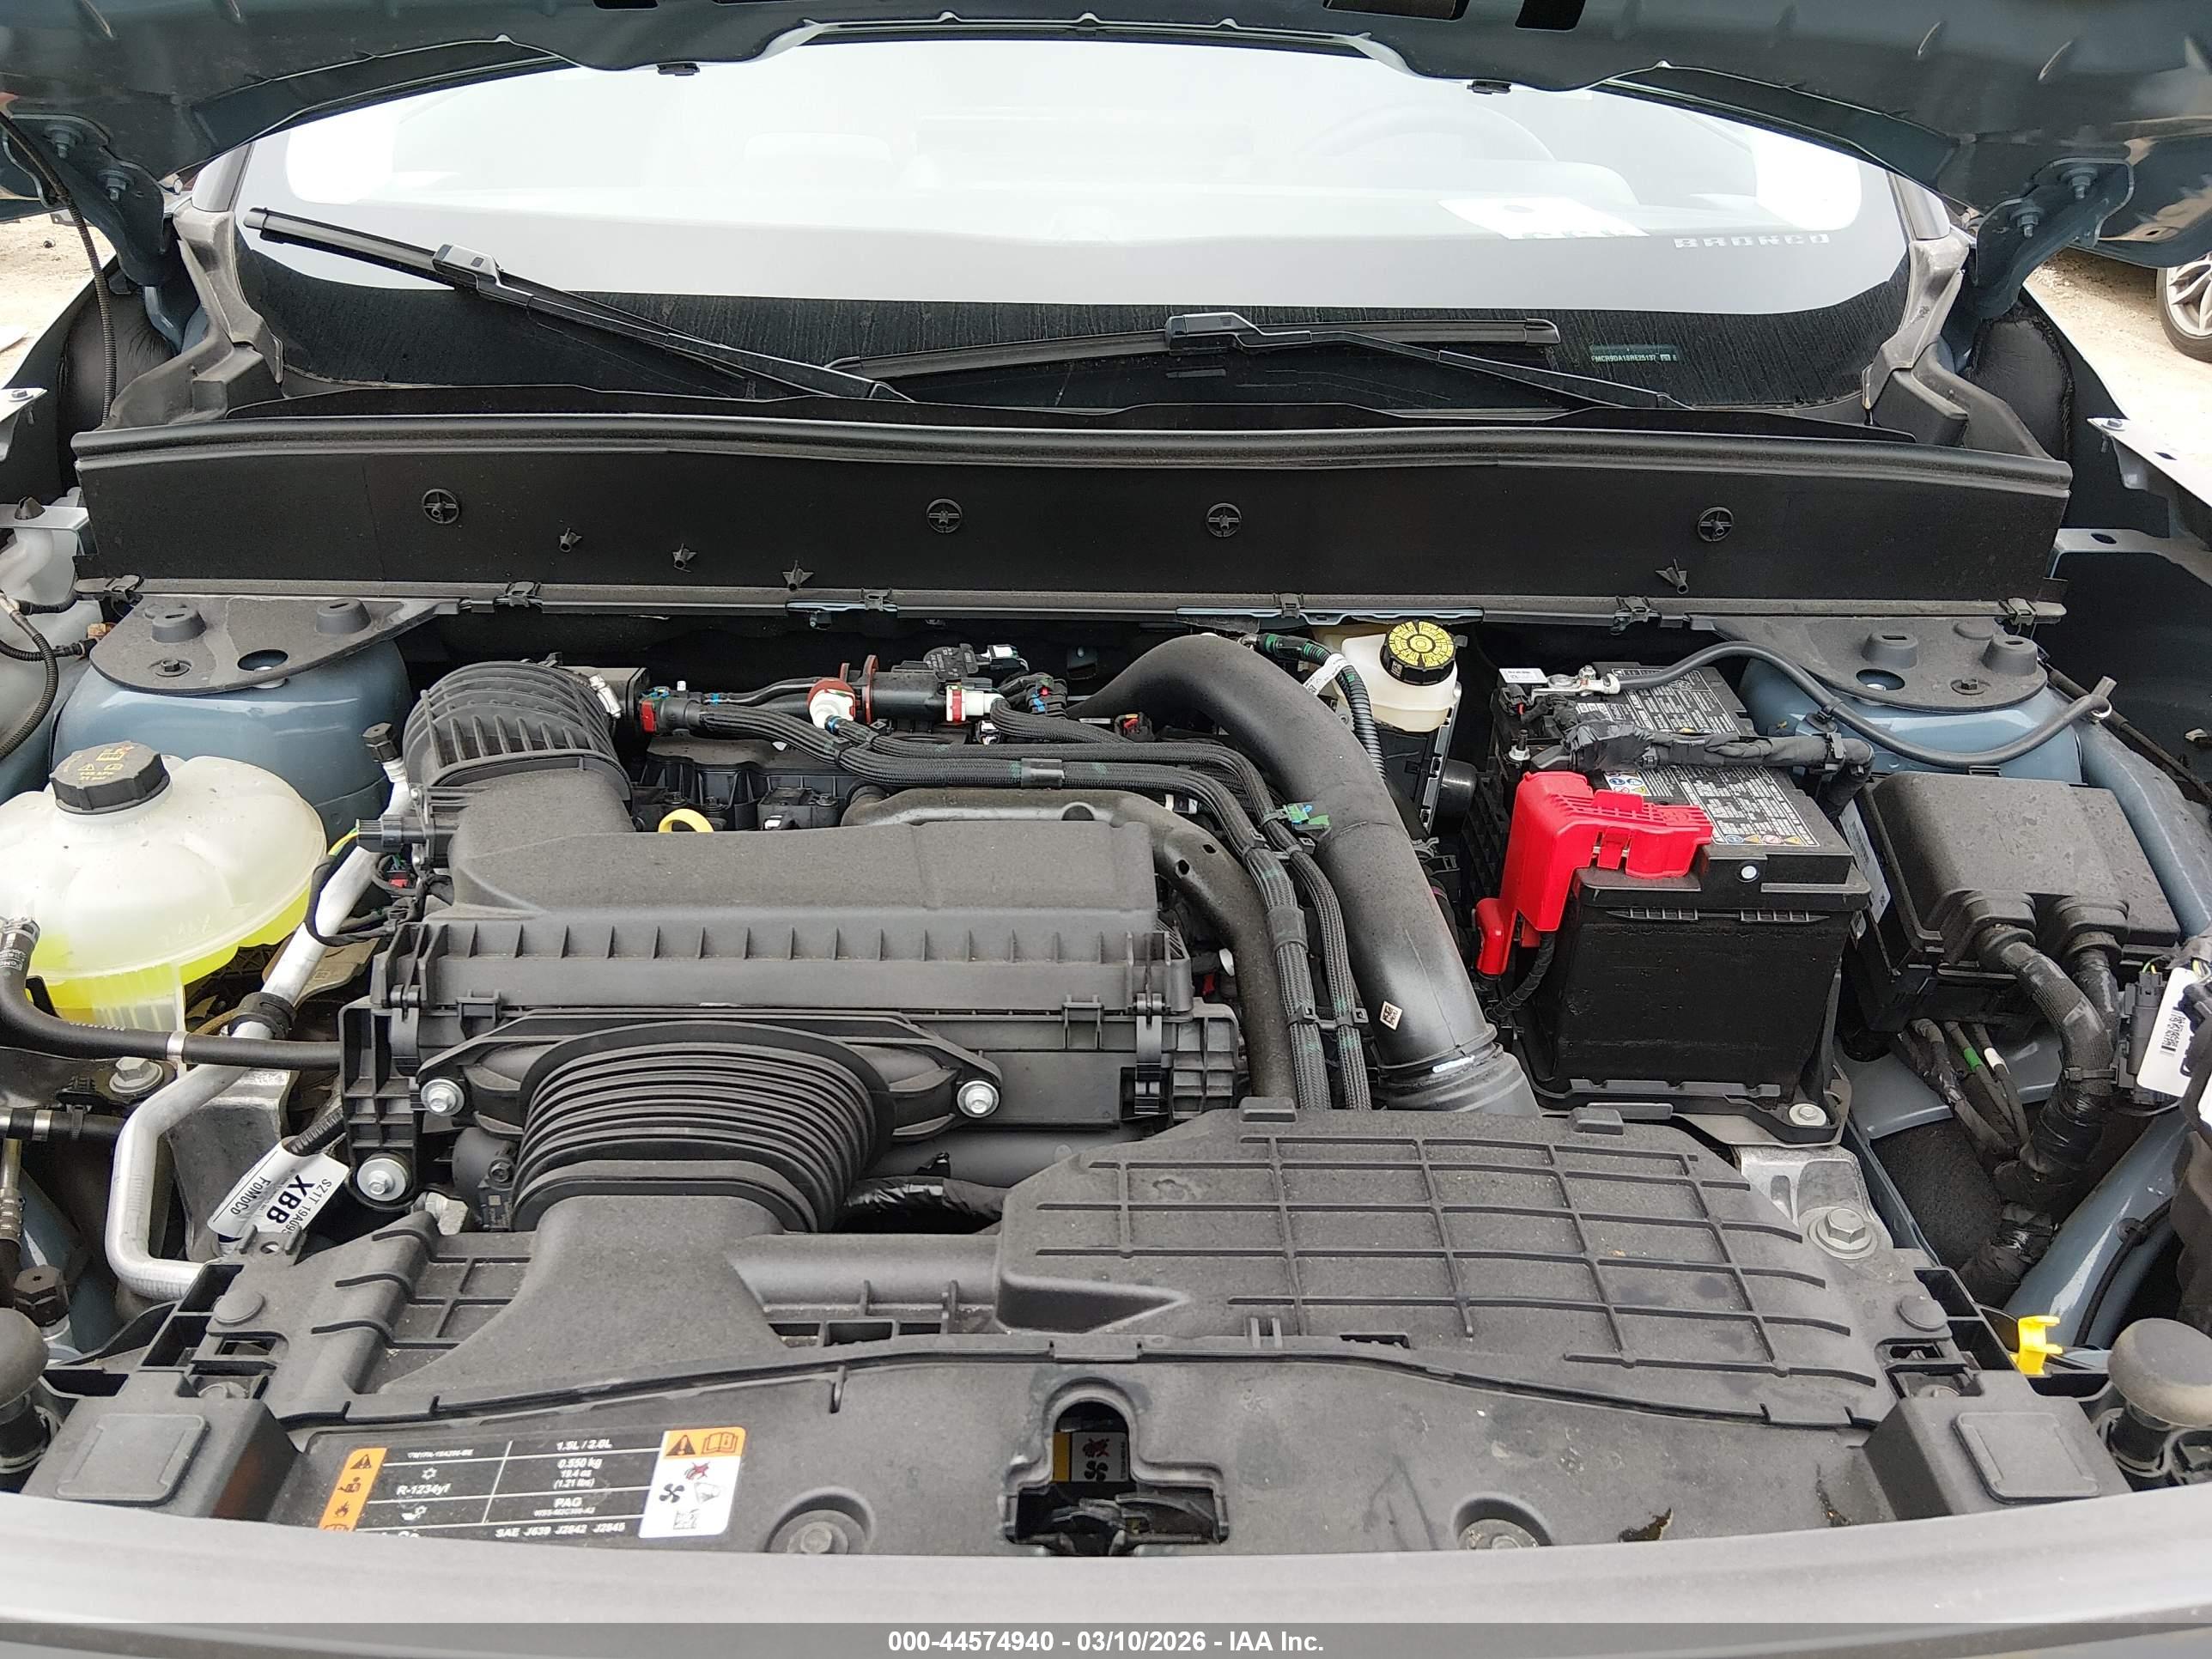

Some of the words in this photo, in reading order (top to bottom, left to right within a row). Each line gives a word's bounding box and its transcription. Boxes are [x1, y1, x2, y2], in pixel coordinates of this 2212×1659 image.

[1674, 233, 1831, 249] BRONCO
[266, 1174, 316, 1224] XBB
[587, 1456, 603, 1469] kg
[495, 1527, 521, 1538] SAE
